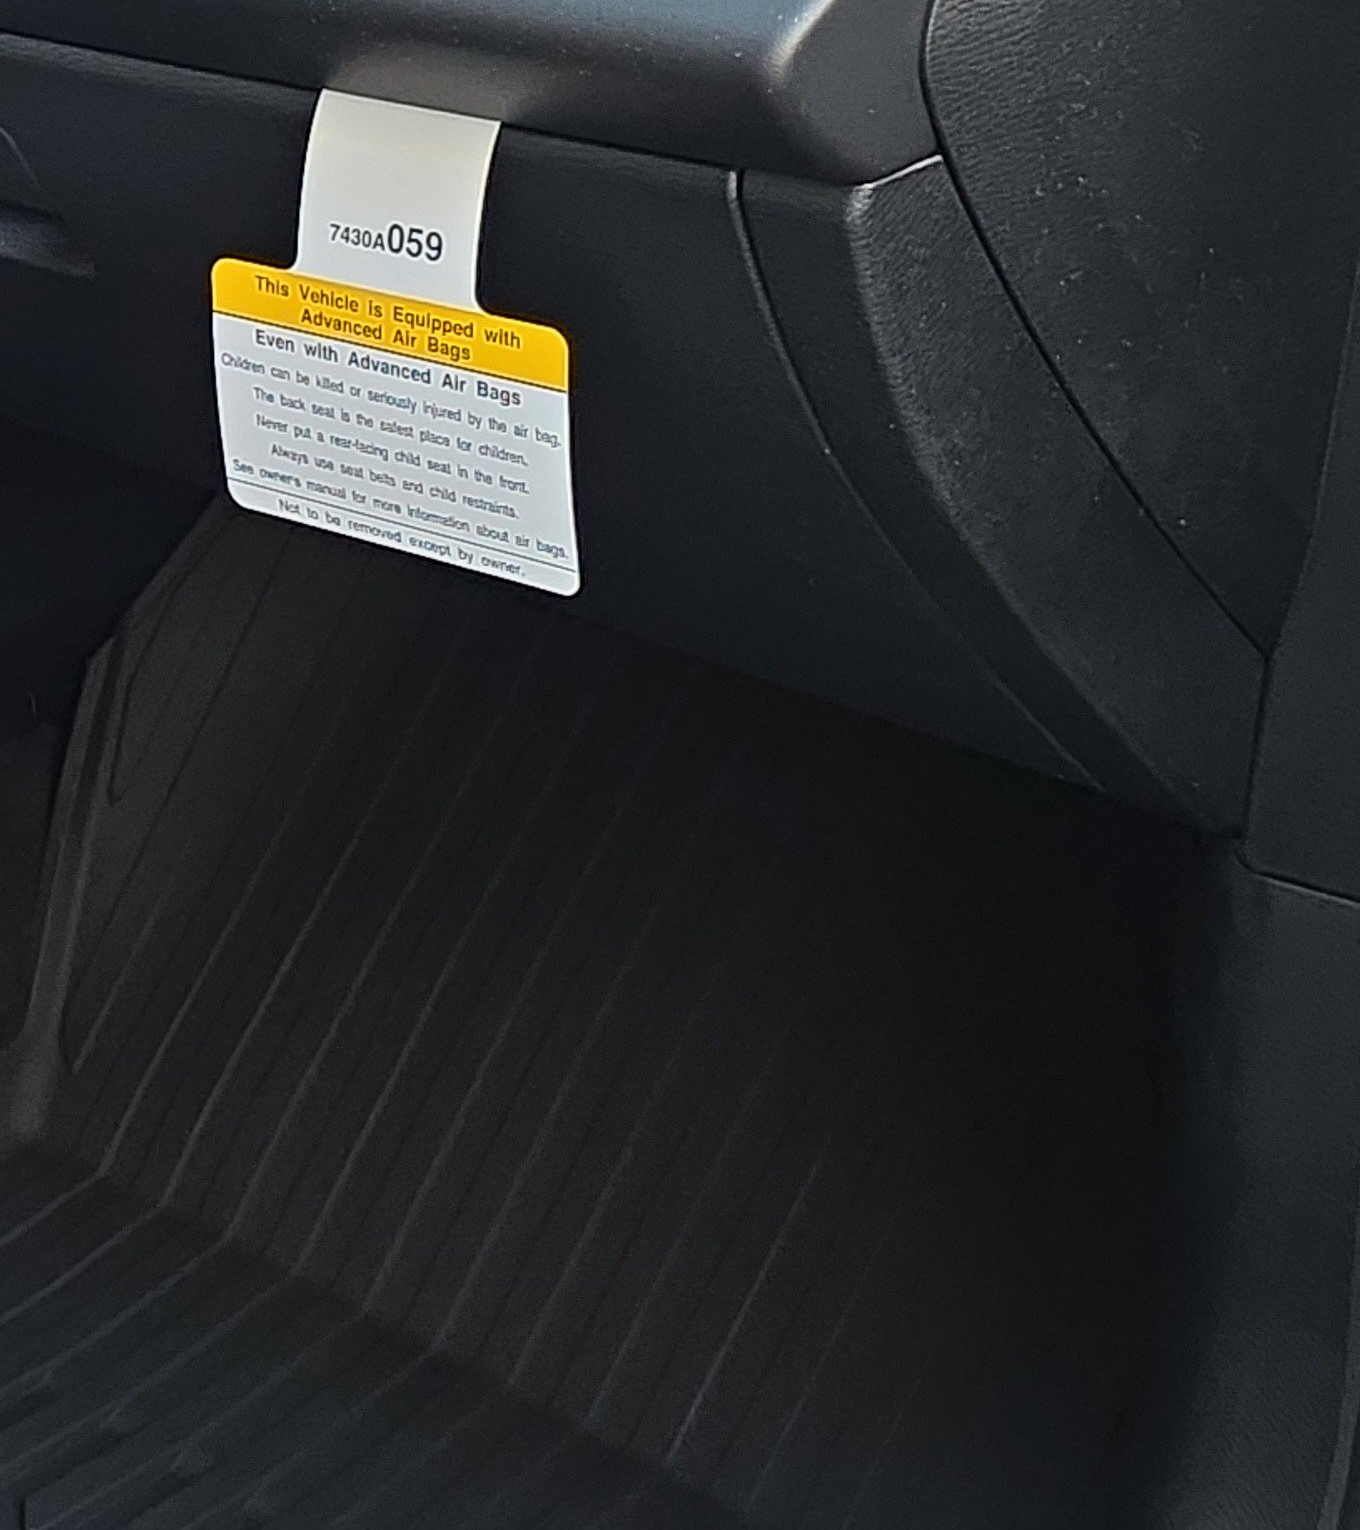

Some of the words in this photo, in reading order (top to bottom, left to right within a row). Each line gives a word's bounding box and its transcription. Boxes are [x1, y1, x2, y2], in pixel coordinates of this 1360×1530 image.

[329, 222, 444, 262] 7430A059
[255, 275, 290, 297] This
[299, 284, 359, 313] Vehicle
[368, 300, 383, 318] is
[393, 306, 474, 339] Equipped
[484, 328, 521, 350] with
[300, 309, 382, 340] Advanced
[392, 329, 418, 348] Air
[427, 336, 471, 362] Bags
[220, 352, 265, 375] Children
[270, 366, 291, 381] can
[296, 371, 310, 386] be
[315, 375, 344, 394] killed
[349, 385, 361, 398] or
[367, 390, 417, 415] seriously
[423, 400, 462, 422] injured
[467, 411, 482, 430] by
[488, 417, 507, 433] the
[514, 423, 528, 438] air
[255, 328, 295, 354] Even
[304, 342, 338, 363] with
[348, 351, 431, 384] Advanced
[441, 372, 467, 393] Air
[476, 380, 521, 406] Bags
[254, 387, 274, 404] The
[280, 394, 306, 412] back
[311, 403, 335, 419] seat
[340, 408, 351, 422] is
[356, 413, 374, 428] the
[380, 420, 414, 438] safest
[419, 430, 450, 447] place
[456, 437, 472, 452] for
[256, 414, 288, 433] Never
[294, 425, 312, 439] put
[317, 432, 325, 443] a
[330, 435, 388, 462] rear-facing
[394, 450, 421, 467] child
[427, 459, 451, 475] seat
[457, 464, 469, 479] in
[474, 470, 493, 485] the
[233, 458, 254, 475] See
[306, 479, 347, 500] manual
[352, 490, 366, 505] for
[373, 497, 401, 514] more
[407, 503, 470, 533] information
[476, 524, 510, 544] about
[515, 534, 530, 548] air
[271, 443, 309, 466] Always
[314, 456, 334, 471] use
[340, 463, 364, 479] seat
[369, 469, 396, 487] belts
[402, 480, 423, 494] and
[430, 485, 456, 503] child
[279, 498, 300, 516] Not
[306, 505, 319, 520] to
[325, 511, 341, 527] be
[348, 519, 402, 543] removed
[409, 535, 451, 557] except
[458, 547, 473, 564] by
